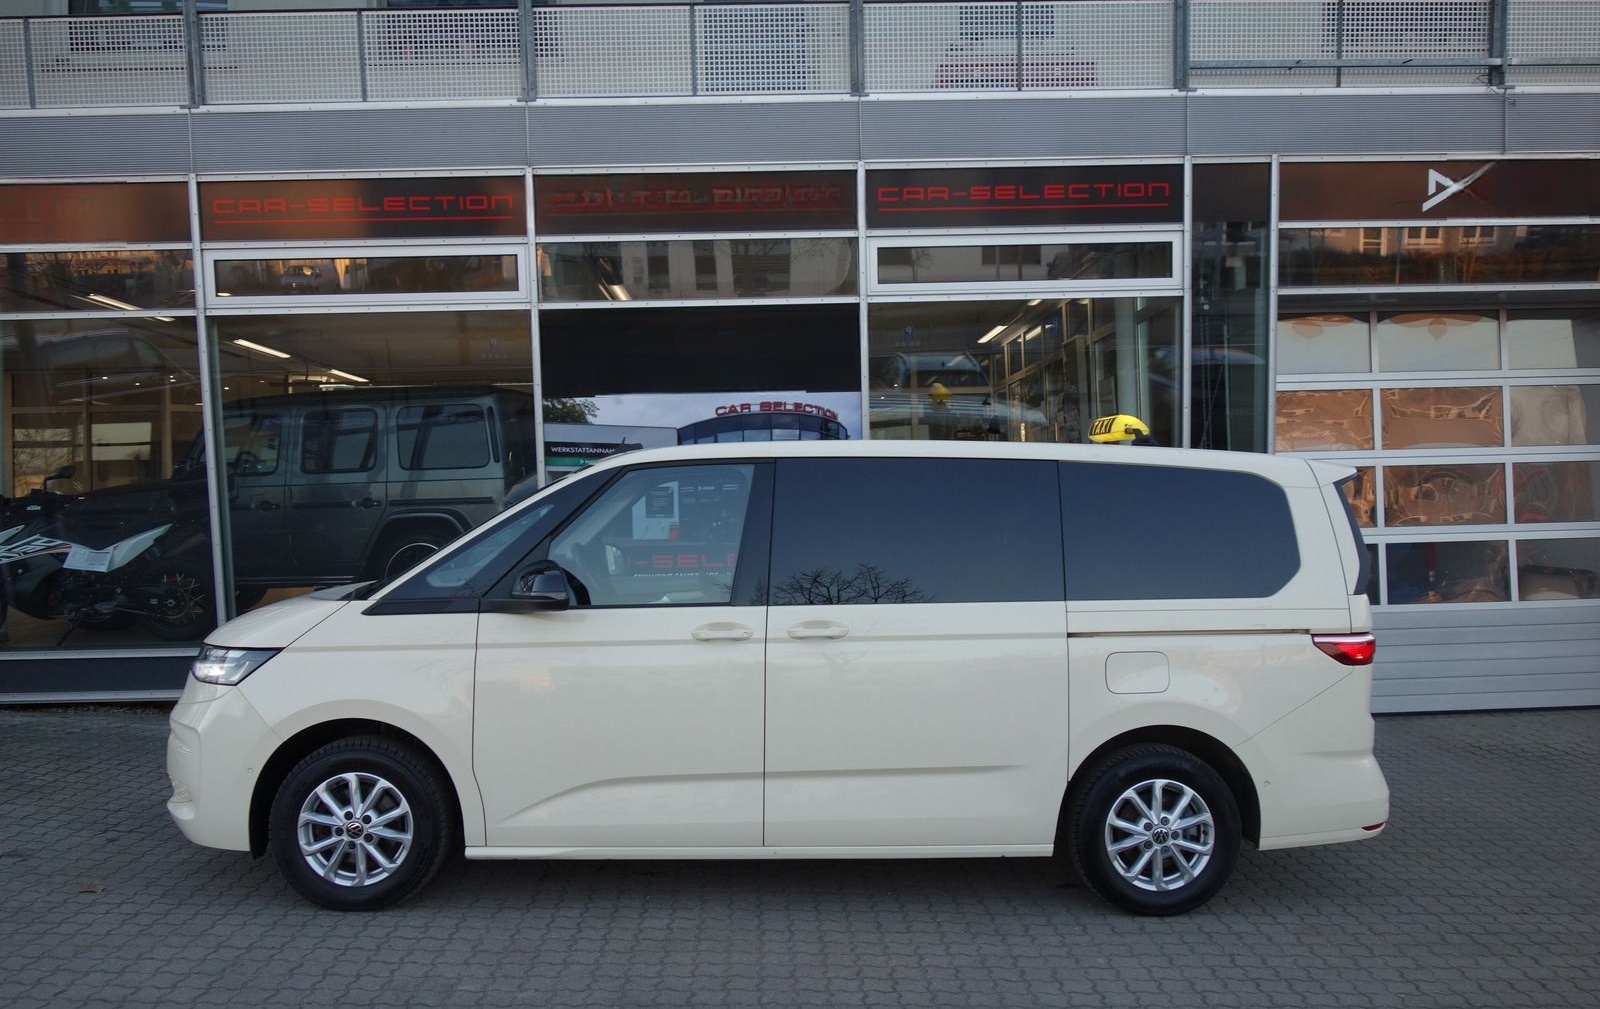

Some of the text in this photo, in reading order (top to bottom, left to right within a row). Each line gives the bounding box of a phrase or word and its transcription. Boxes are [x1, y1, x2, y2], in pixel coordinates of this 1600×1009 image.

[878, 183, 1169, 201] CAR-SELECTION
[214, 195, 512, 214] CAR-SELECTION
[715, 402, 751, 416] CAR
